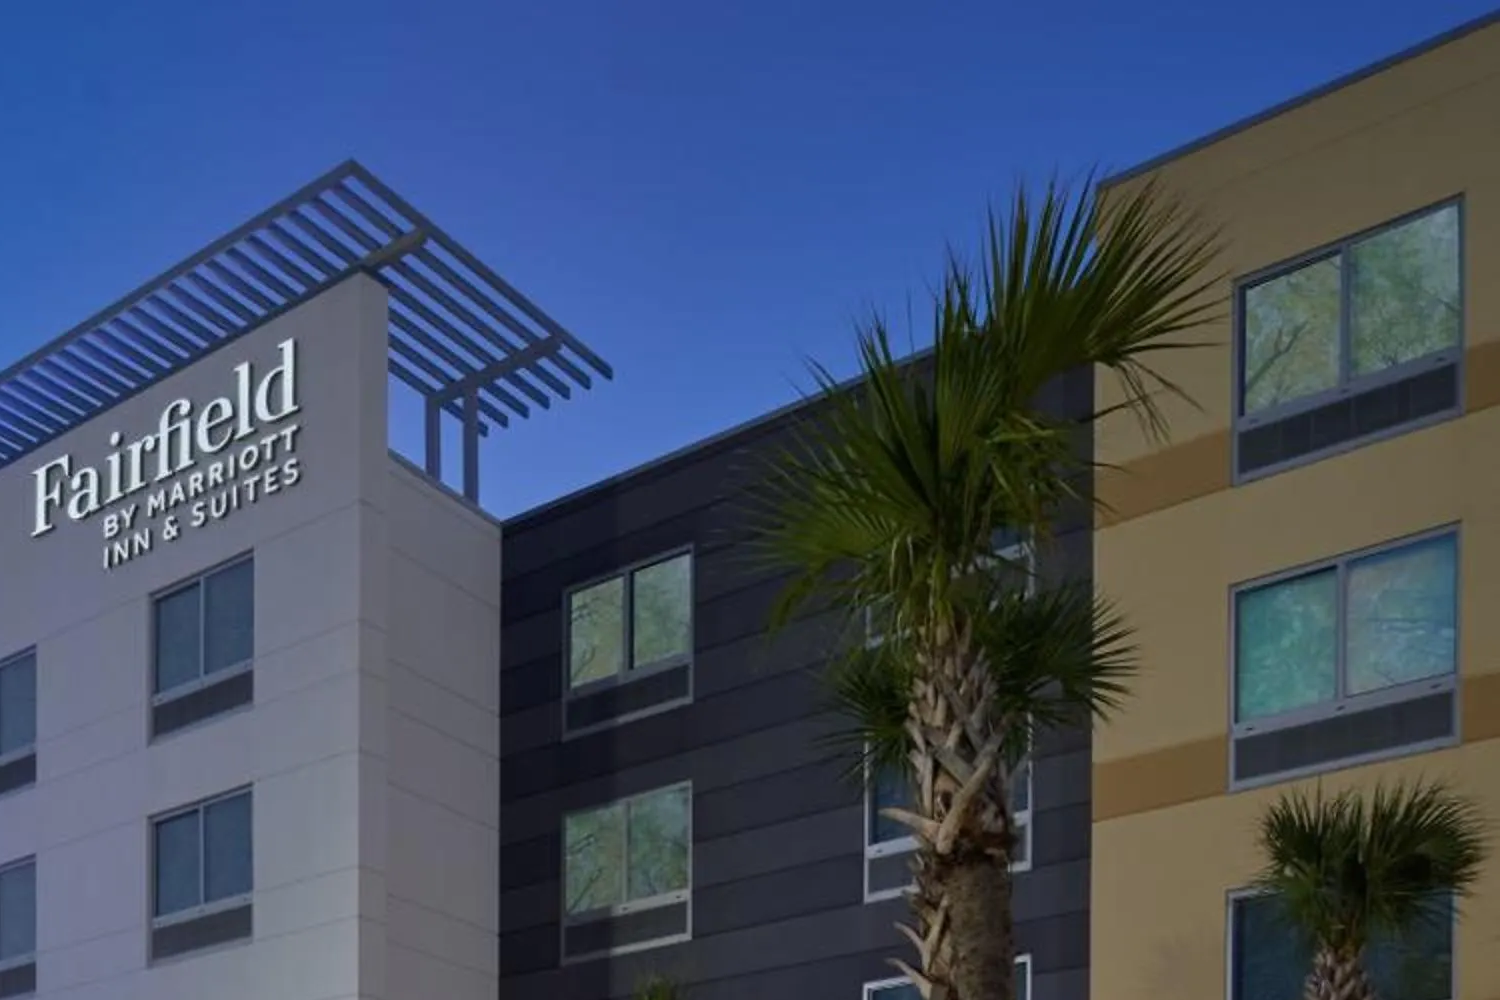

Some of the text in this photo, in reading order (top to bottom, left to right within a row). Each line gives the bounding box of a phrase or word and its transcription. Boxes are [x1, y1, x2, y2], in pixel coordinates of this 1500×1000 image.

[31, 338, 301, 537] Fairfield
[103, 425, 299, 538] BY MARRIOTT
[103, 458, 300, 569] INN & SUITES
